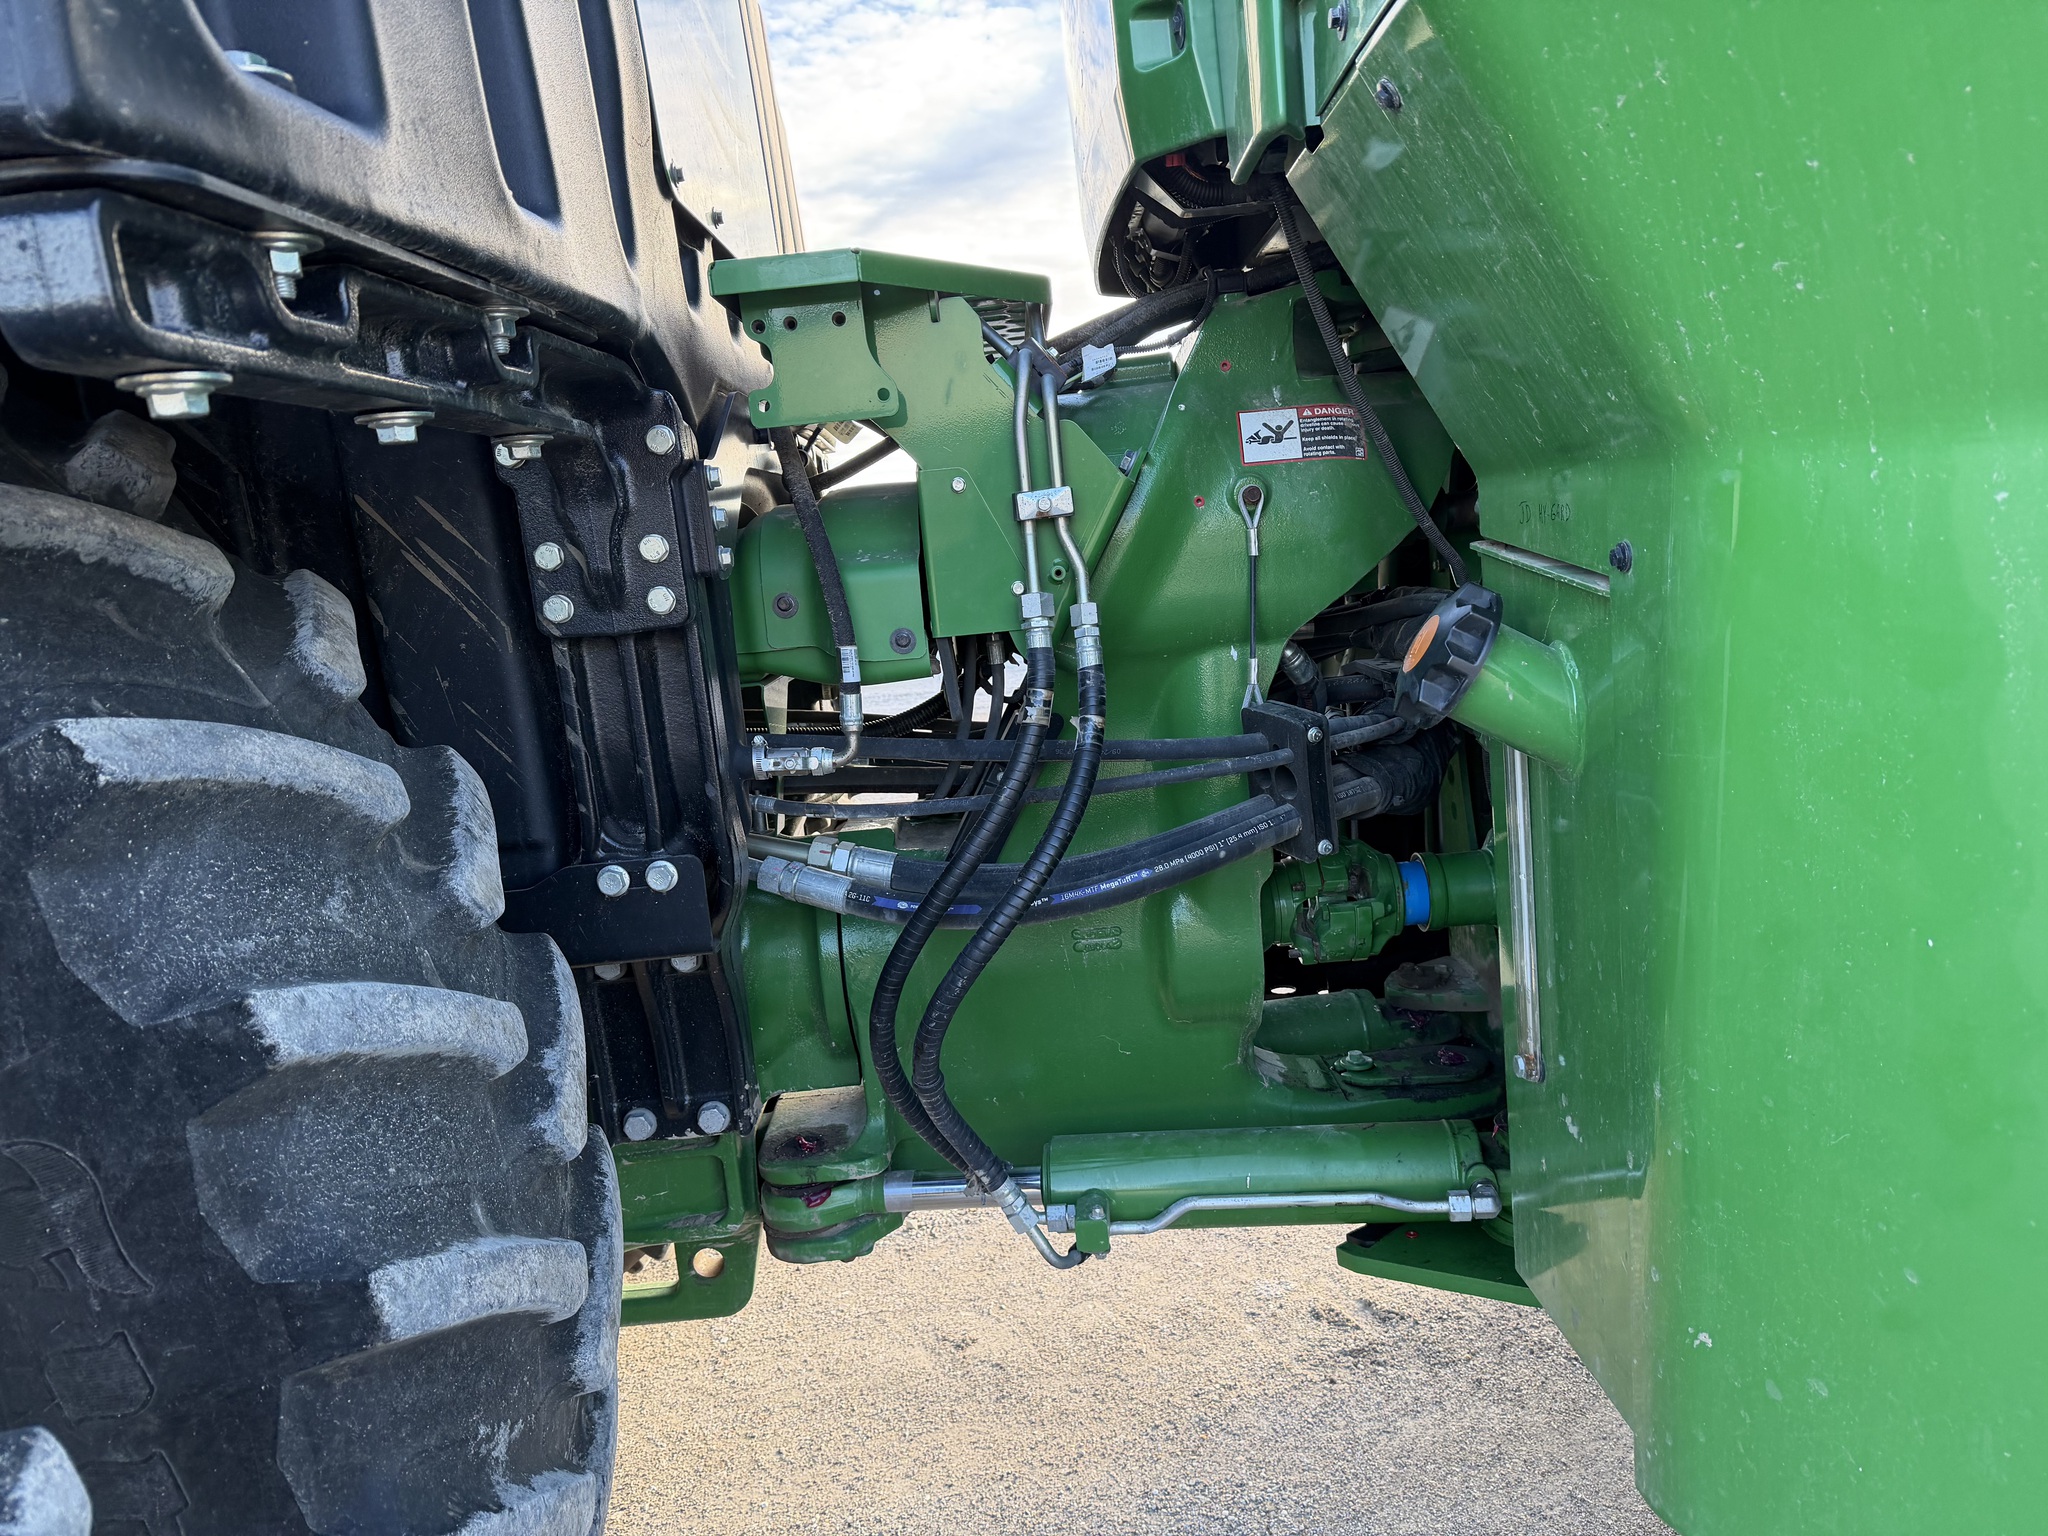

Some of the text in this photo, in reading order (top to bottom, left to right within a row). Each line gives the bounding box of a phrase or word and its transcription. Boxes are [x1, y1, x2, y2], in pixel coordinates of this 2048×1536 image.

[1314, 407, 1355, 416] DANGER
[1518, 500, 1532, 524] JD
[1154, 862, 1170, 874] 28.0
[1170, 858, 1185, 868] MPa
[1243, 826, 1259, 839] mm)
[1258, 822, 1269, 831] ISO
[847, 890, 871, 903] 2G-11C
